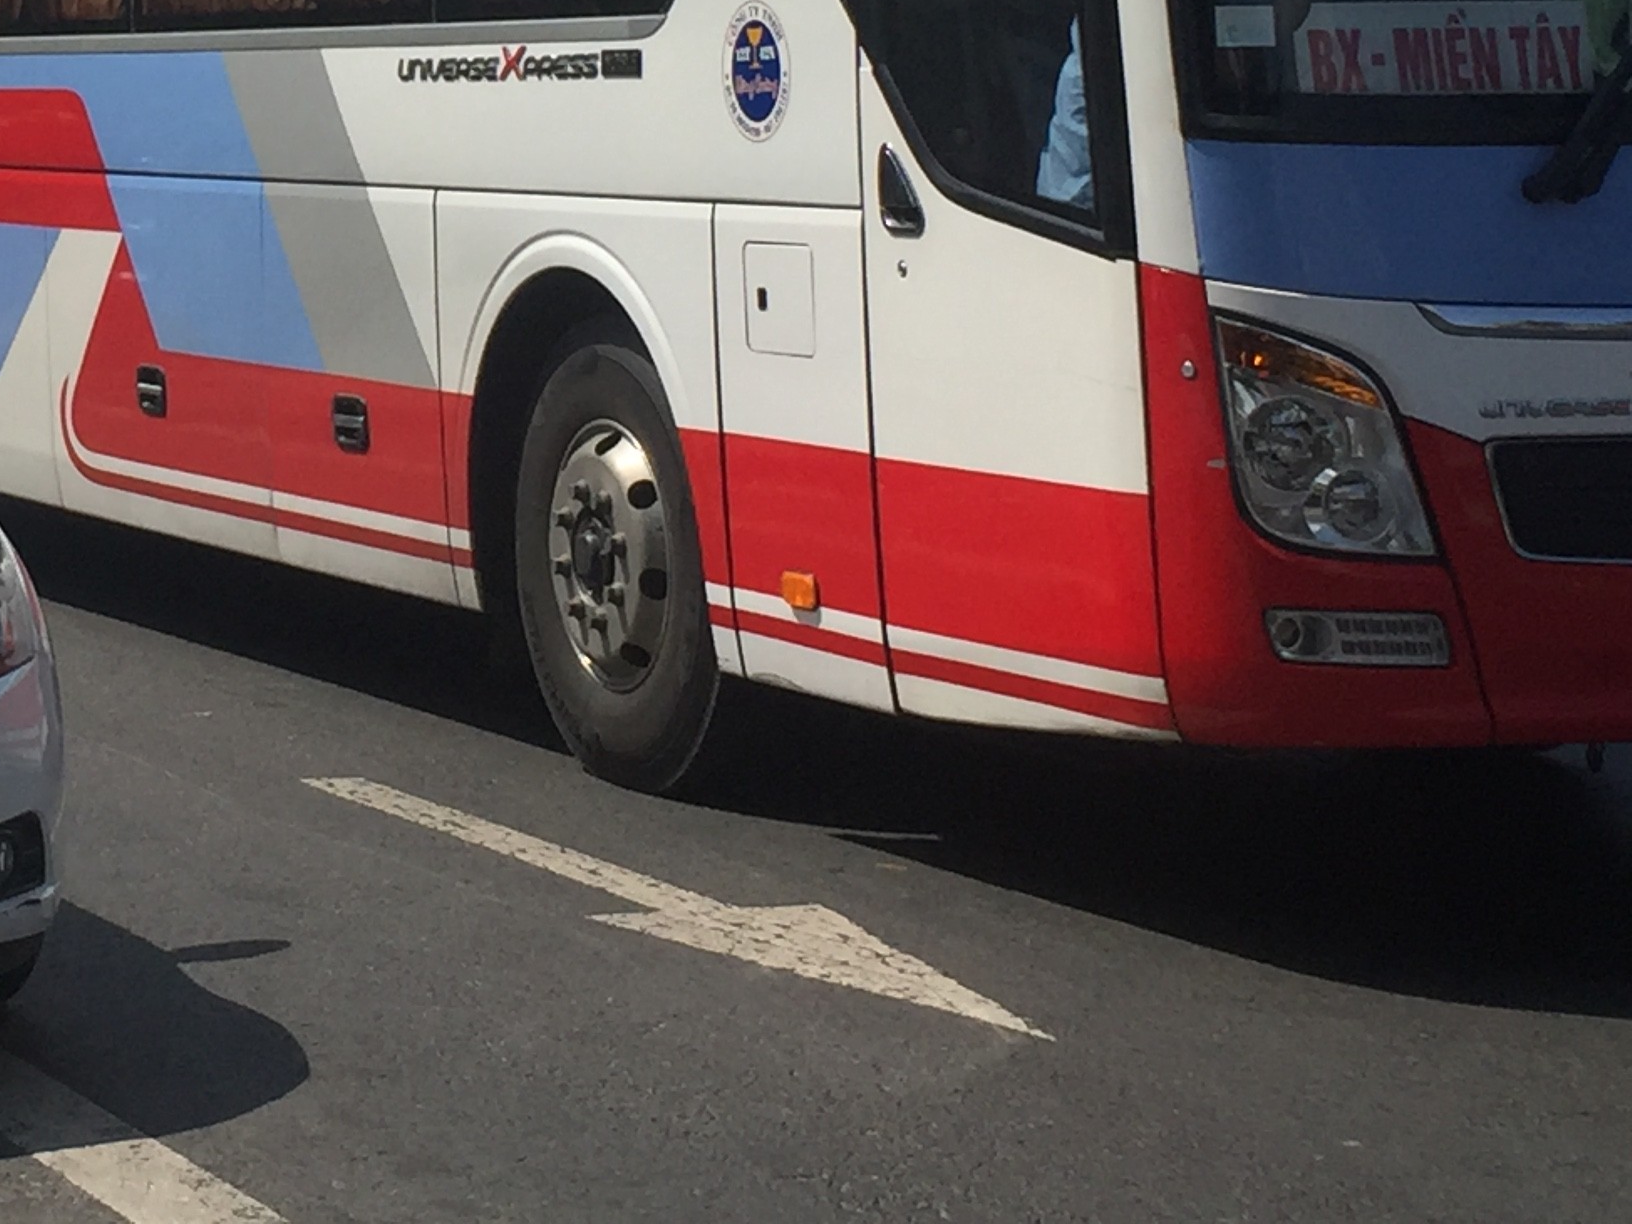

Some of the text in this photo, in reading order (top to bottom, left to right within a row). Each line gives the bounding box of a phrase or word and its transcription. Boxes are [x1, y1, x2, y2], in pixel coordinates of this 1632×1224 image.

[1307, 26, 1367, 92] BX
[1393, 7, 1501, 92] MIỀN
[1509, 12, 1583, 91] TÂY
